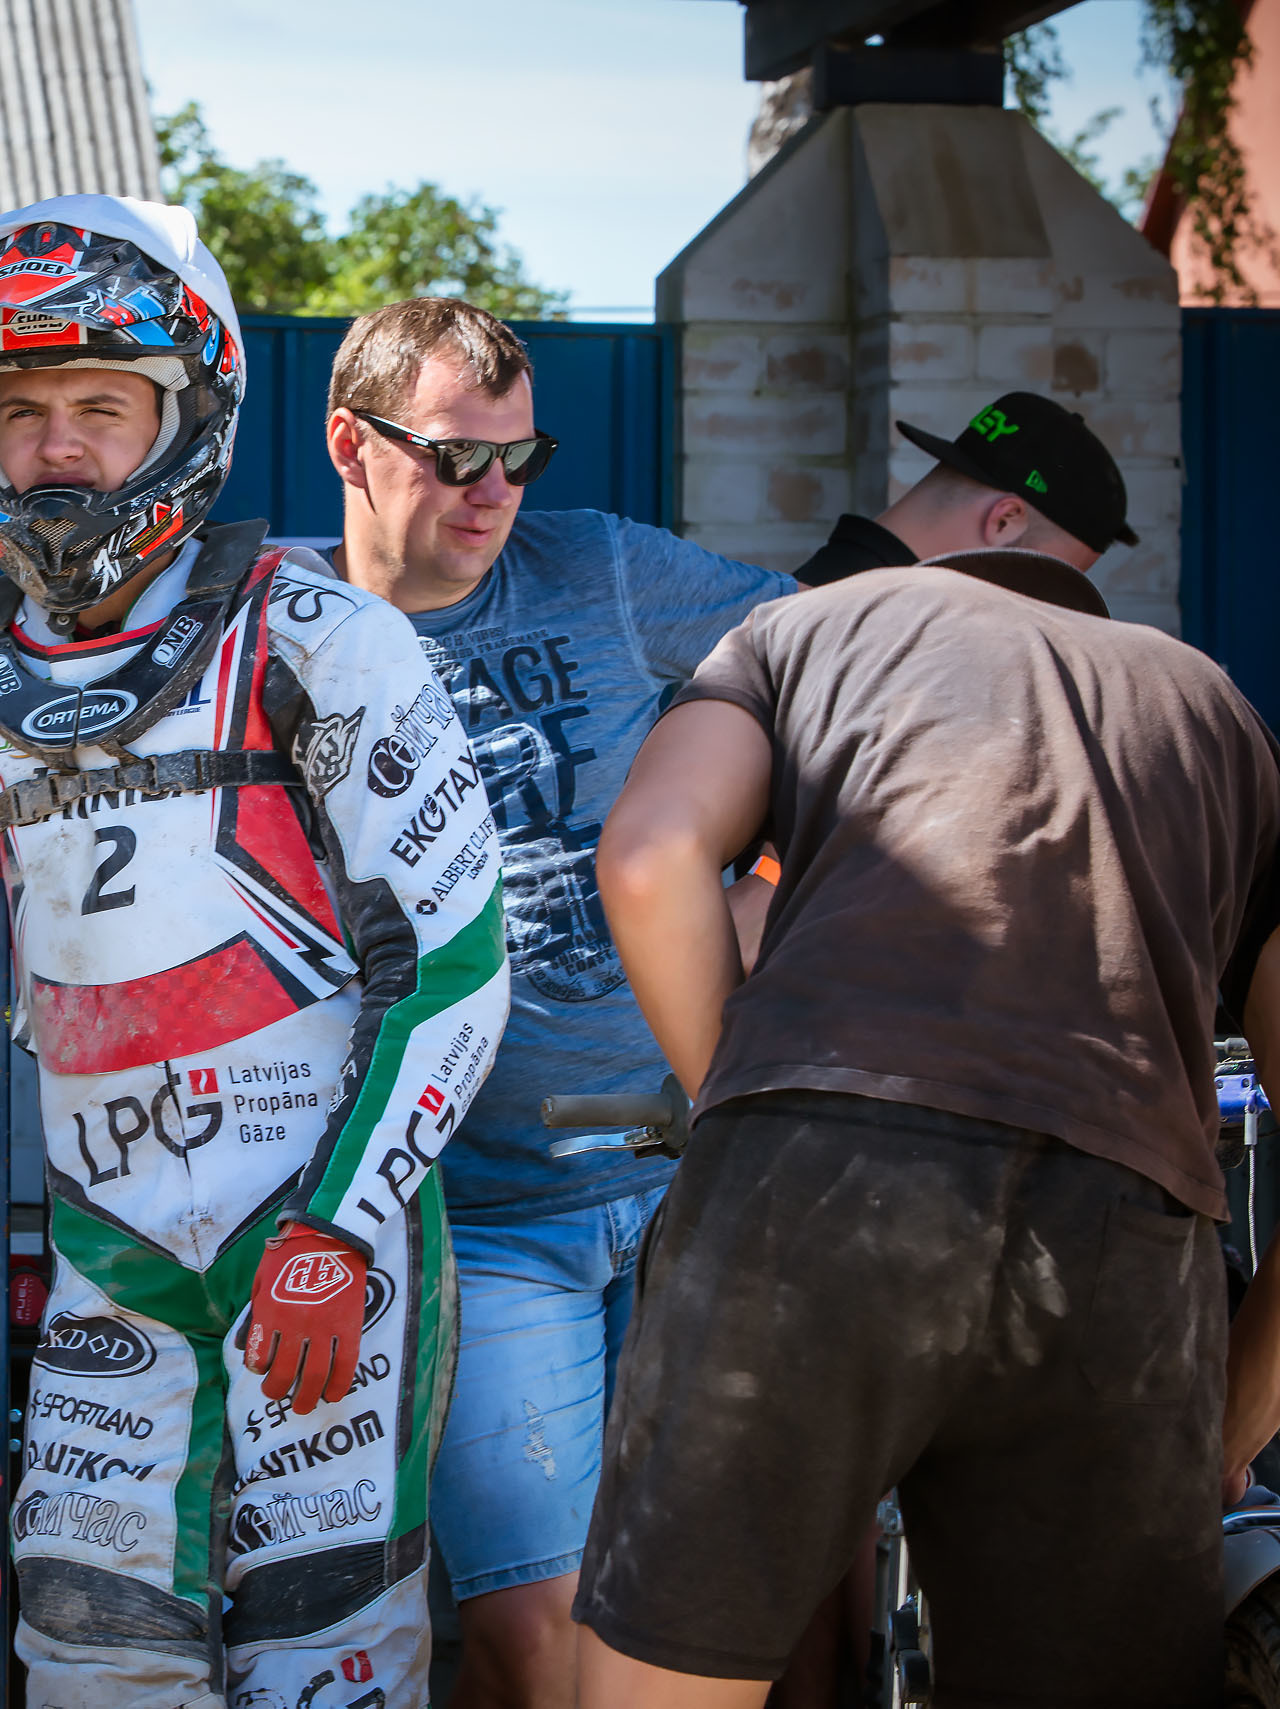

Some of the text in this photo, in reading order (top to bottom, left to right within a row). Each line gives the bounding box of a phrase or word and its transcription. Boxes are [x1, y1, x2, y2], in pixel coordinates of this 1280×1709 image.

[36, 700, 121, 728] ORTEMA
[370, 671, 457, 791] Сейча
[390, 744, 480, 869] EKOTAX
[81, 825, 137, 916] 2
[432, 844, 477, 902] ALBERT
[229, 1060, 312, 1085] Latvijas
[431, 1022, 475, 1084] Latvijas
[72, 1062, 223, 1188] LPG
[235, 1090, 319, 1117] Propāna
[239, 1124, 287, 1144] Gāze
[40, 1392, 154, 1440] SPORTLAND
